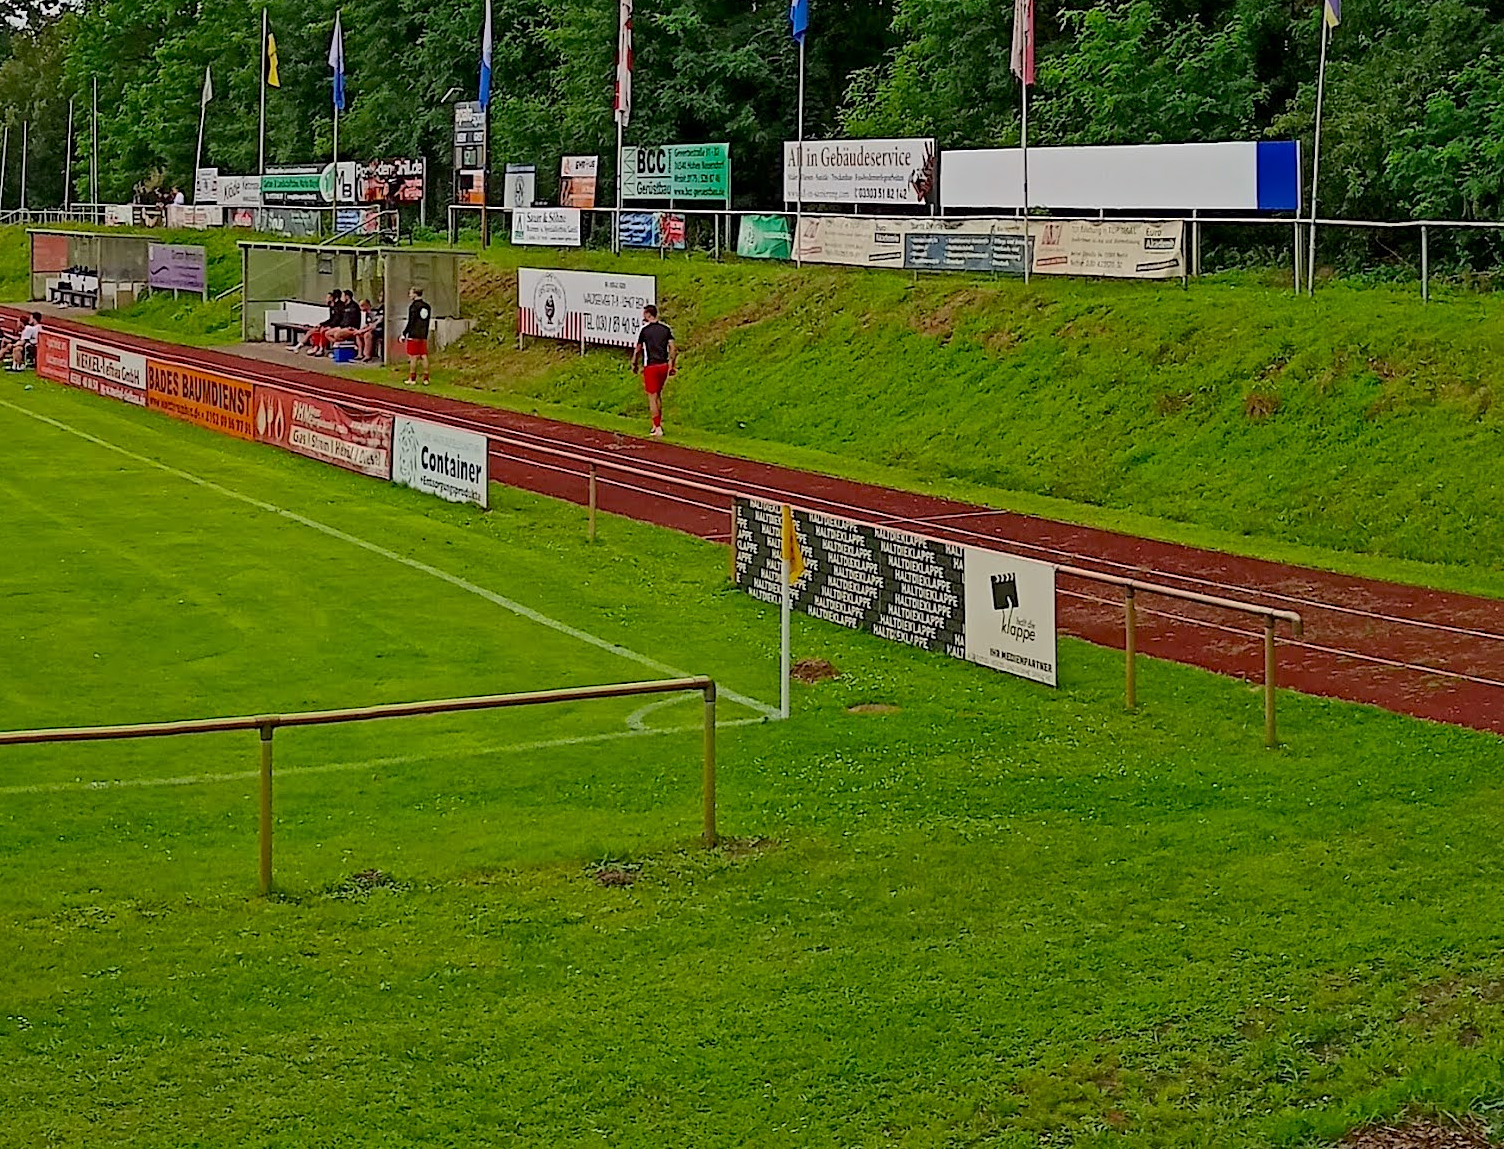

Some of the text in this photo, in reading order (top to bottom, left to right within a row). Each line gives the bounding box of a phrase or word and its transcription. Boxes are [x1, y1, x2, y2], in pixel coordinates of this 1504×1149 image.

[637, 149, 666, 173] BCC
[806, 148, 818, 167] in
[821, 145, 911, 168] Gebäudeservice
[637, 181, 672, 195] Gerüstbau
[148, 366, 179, 398] BADES
[182, 372, 252, 417] BAUMDIENST
[293, 430, 306, 445] Gas
[421, 446, 482, 484] Container
[815, 525, 865, 547] HALTDIEKLAPPE
[881, 541, 936, 564] HALTDIEKLAPPE
[822, 539, 872, 561] HALTDIEKLAPPE
[888, 555, 944, 578] HALTDIEKLAPPE
[828, 552, 878, 574] HALTDIEKLAPPE
[895, 569, 951, 593] HALTDIEKLAPPE
[833, 565, 884, 588] HALTDIEKLAPPE
[901, 583, 958, 607] HALTDIEKLAPPE
[821, 585, 872, 609] HALTDIEKLAPPE
[888, 603, 944, 629] HALTDIEKLAPPE
[828, 575, 878, 599] HALTDIEKLAPPE
[895, 593, 951, 618] HALTDIEKLAPPE
[808, 605, 857, 628] HALTDIEKLAPPE
[873, 623, 928, 649] HALTDIEKLAPPE
[814, 595, 864, 619] HALTDIEKLAPPE
[880, 614, 936, 639] HALTDIEKLAPPE
[1001, 624, 1036, 643] klappe
